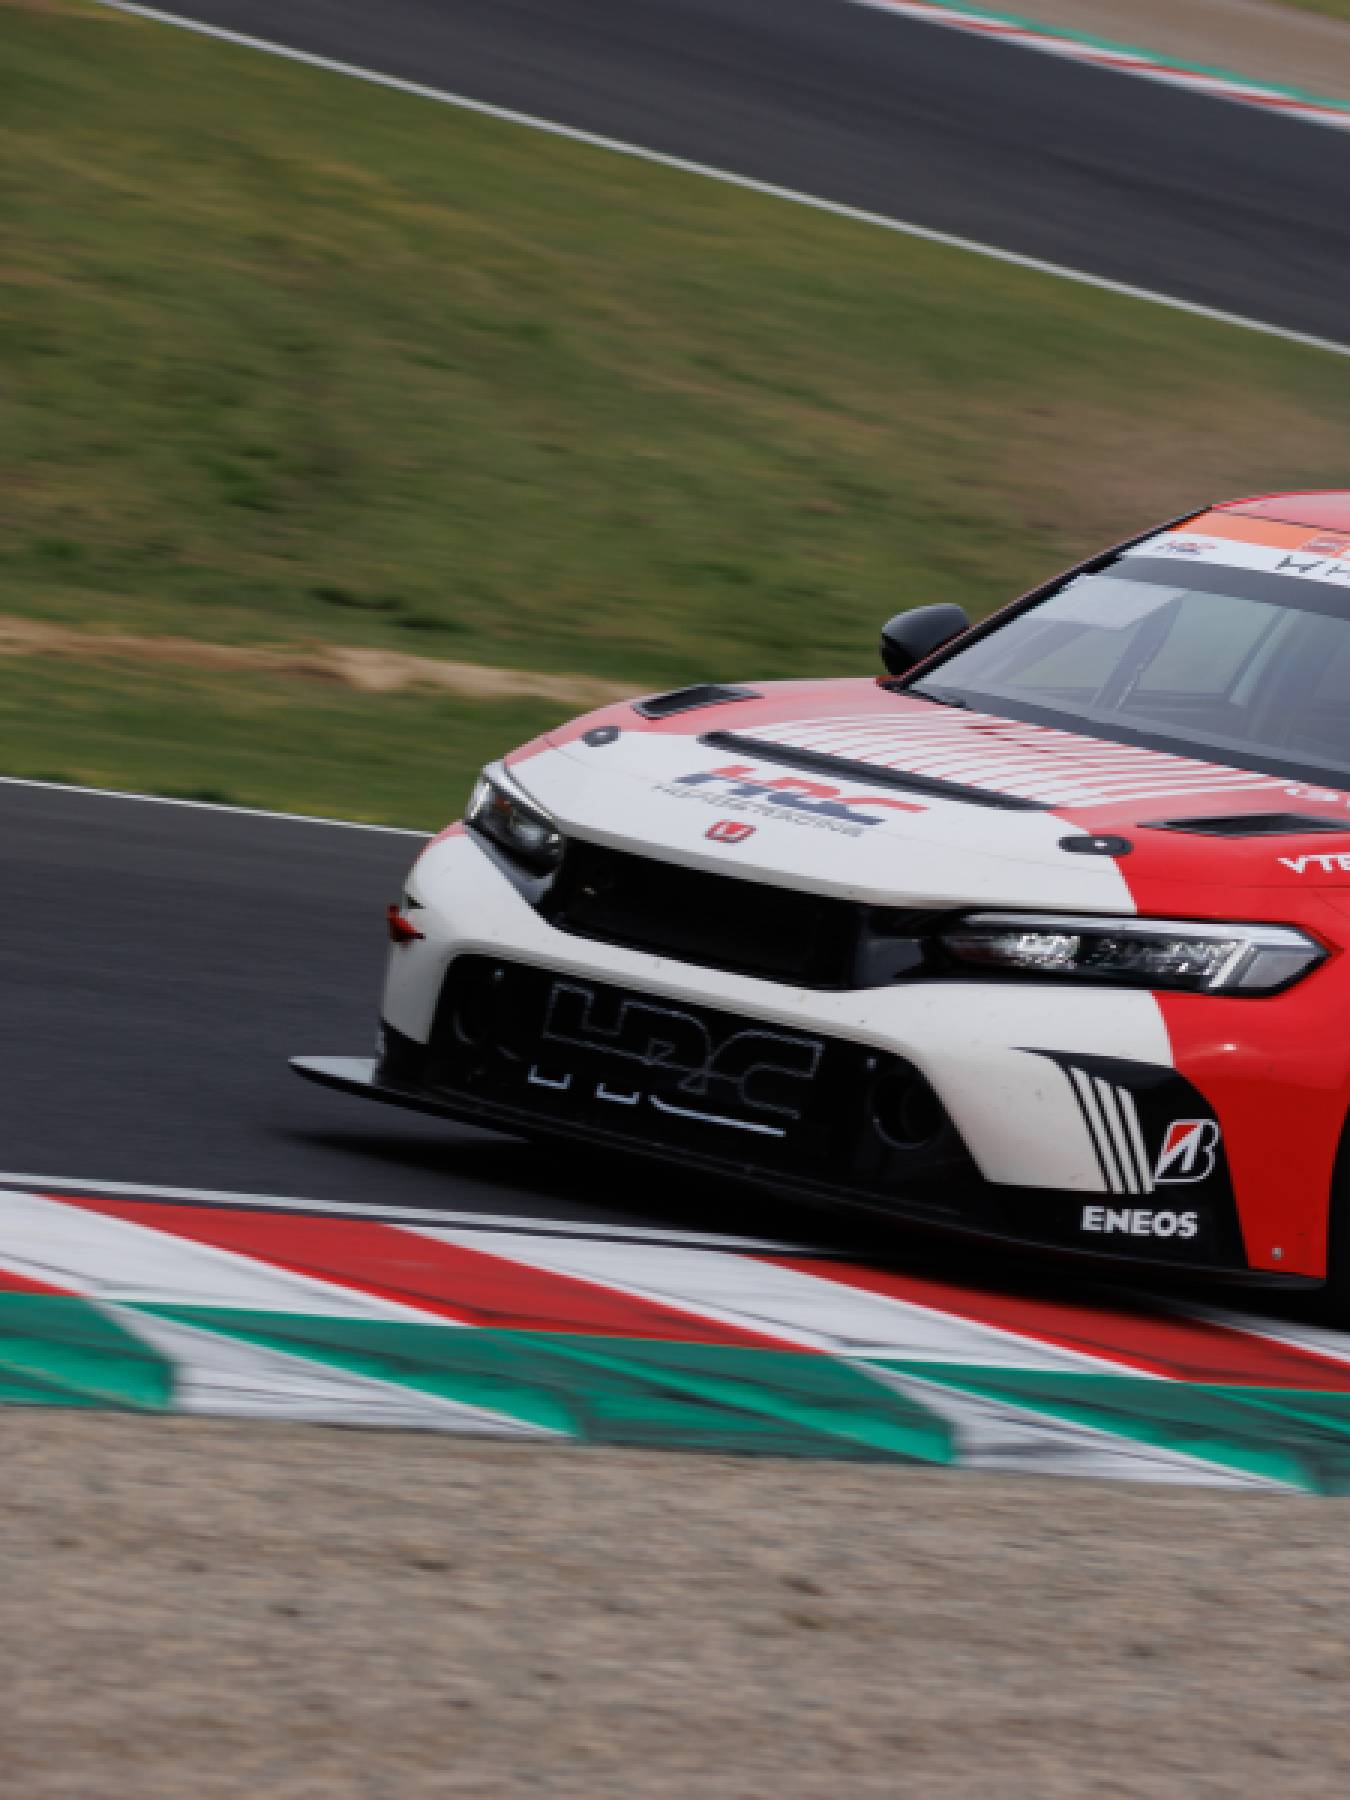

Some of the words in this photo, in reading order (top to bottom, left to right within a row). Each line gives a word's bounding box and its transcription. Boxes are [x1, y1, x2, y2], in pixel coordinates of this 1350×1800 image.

[674, 764, 930, 825] HRC
[528, 982, 825, 1137] HRC
[1081, 1205, 1199, 1239] ENEOS
